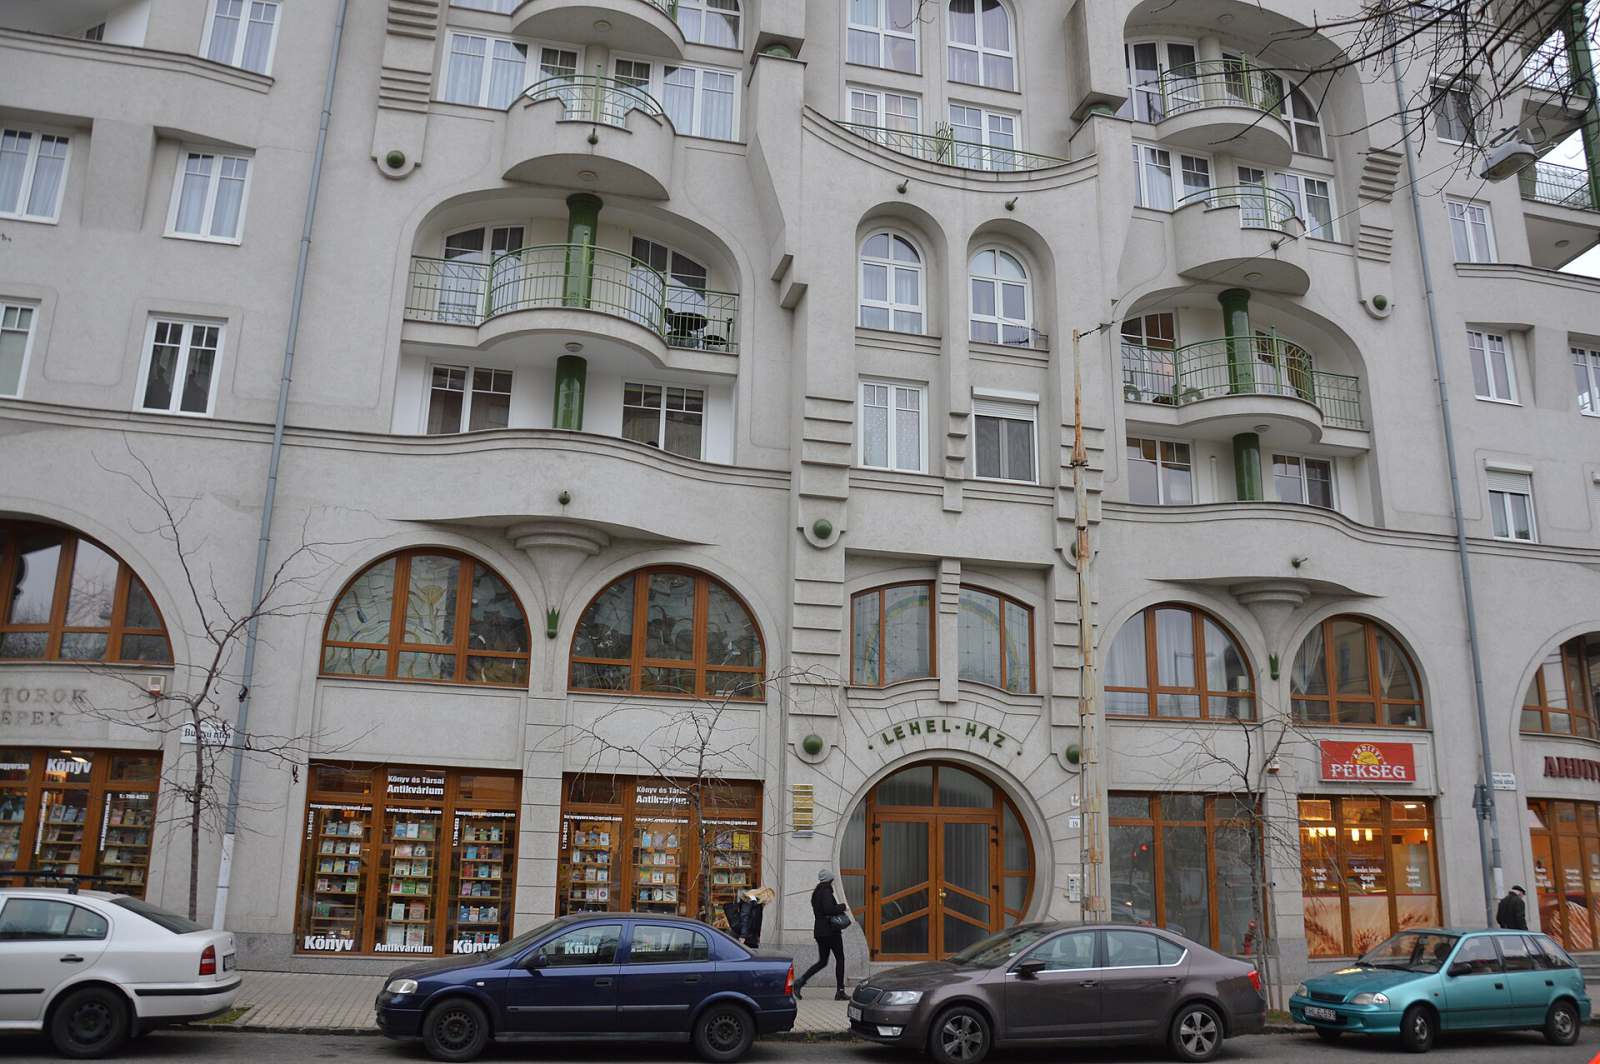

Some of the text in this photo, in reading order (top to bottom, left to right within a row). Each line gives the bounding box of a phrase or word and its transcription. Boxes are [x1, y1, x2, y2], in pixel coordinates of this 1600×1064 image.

[881, 719, 1006, 748] LEHEL-HÁZ
[46, 757, 93, 774] Könyv
[1330, 760, 1406, 779] PÉKSÉG
[387, 775, 445, 785] Könyv és Társai
[387, 784, 444, 795] Antikvárium
[636, 786, 657, 794] Könyv
[304, 935, 354, 952] Könyv
[374, 942, 433, 953] Antikvárium
